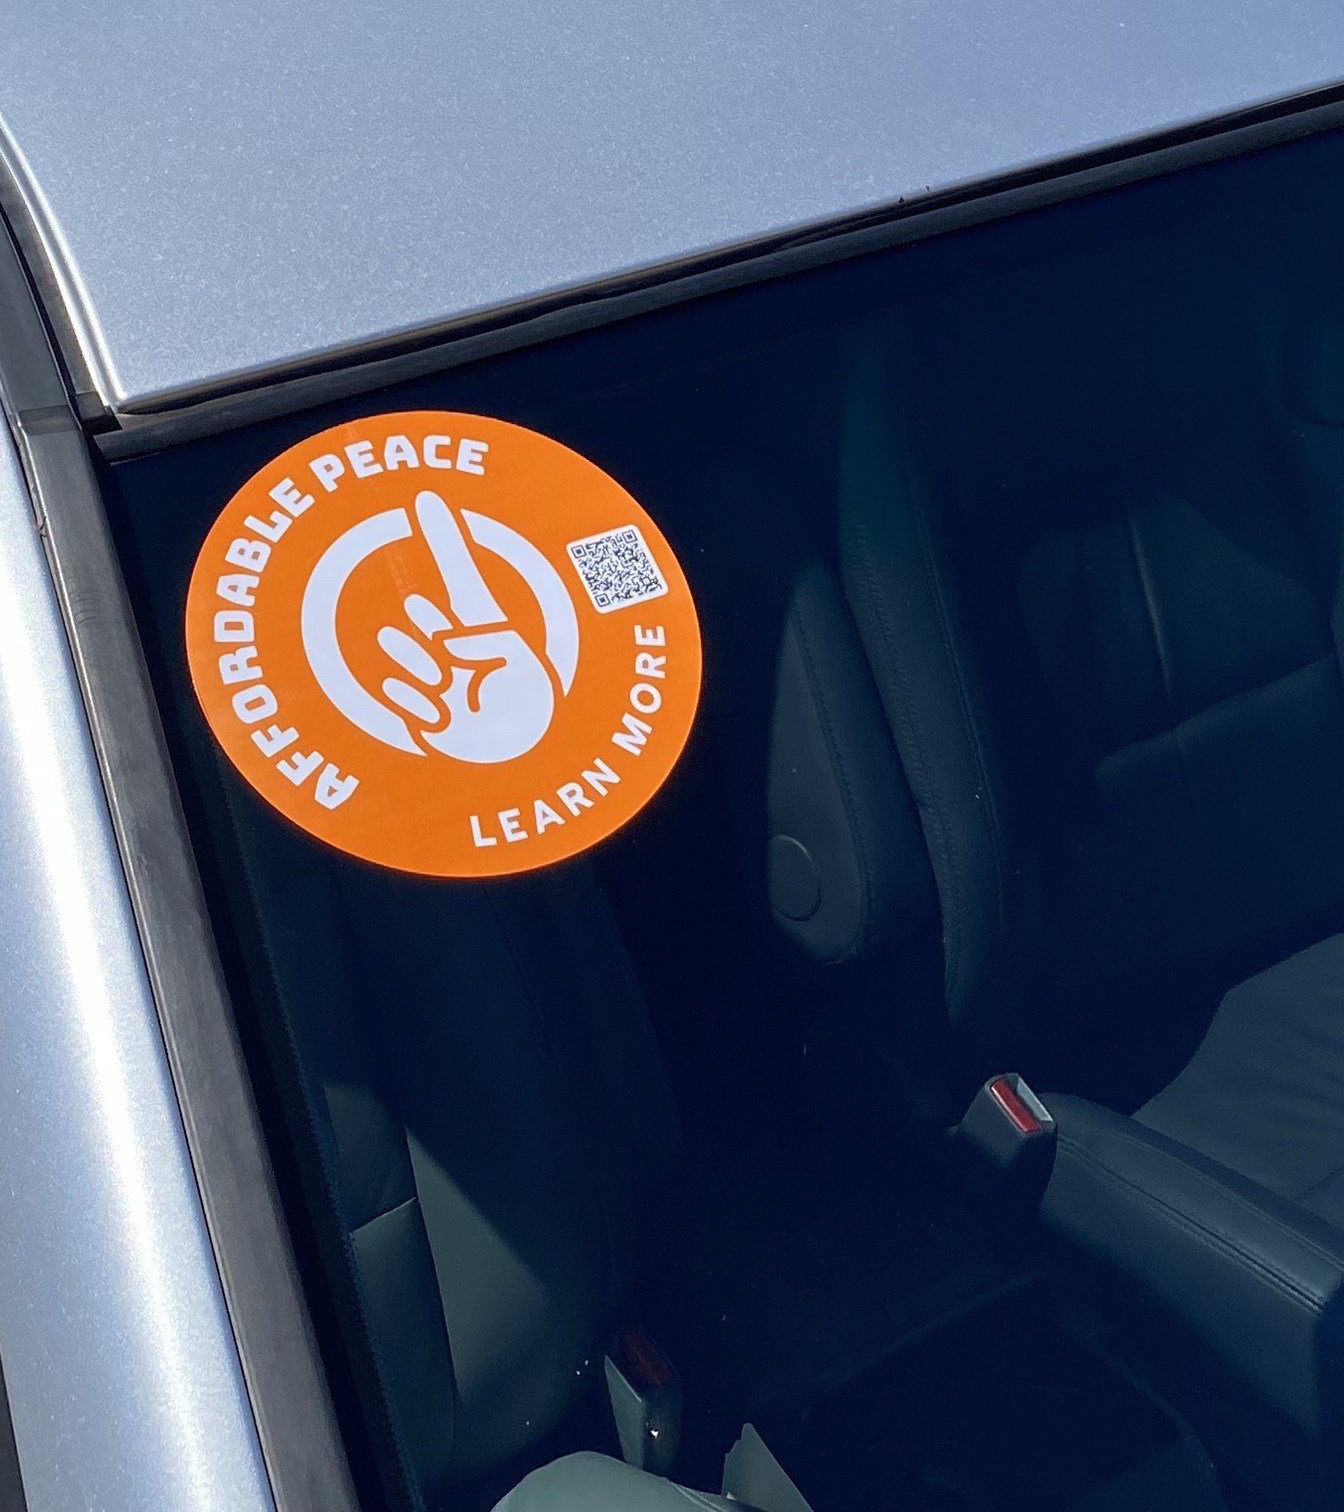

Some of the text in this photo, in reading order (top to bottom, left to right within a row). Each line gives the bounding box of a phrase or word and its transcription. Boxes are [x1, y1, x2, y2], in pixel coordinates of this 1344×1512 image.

[213, 434, 490, 810] AFFORDABLE PEACE
[469, 624, 667, 848] LEARN MORE
